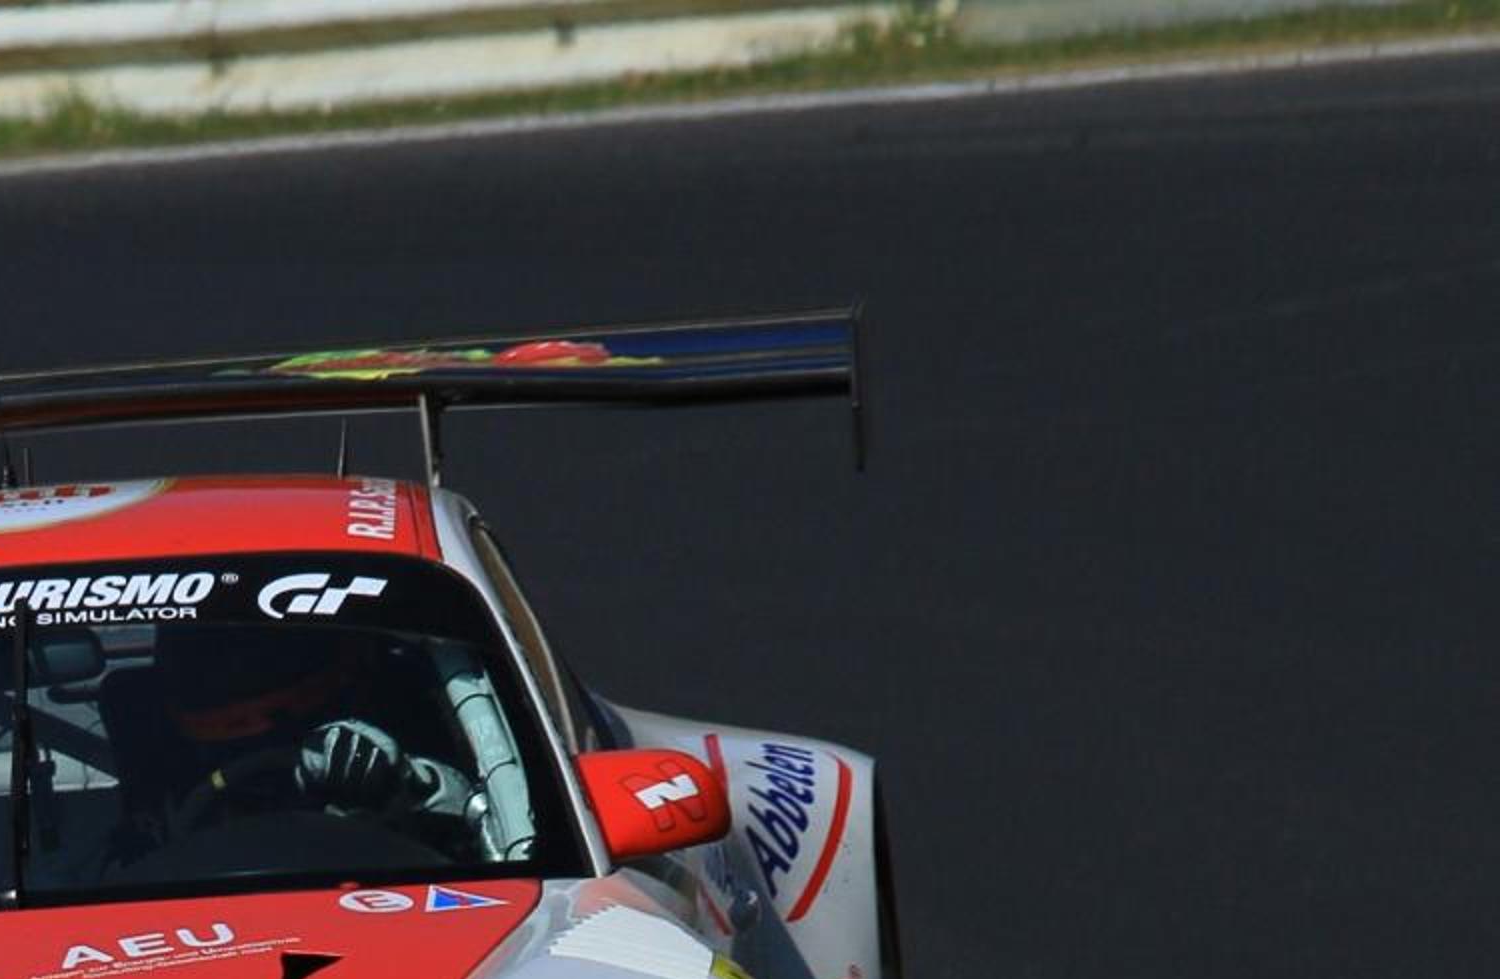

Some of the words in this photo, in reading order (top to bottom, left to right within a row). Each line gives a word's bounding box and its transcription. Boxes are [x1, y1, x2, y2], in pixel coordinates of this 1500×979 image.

[36, 607, 197, 625] SIMULATOR
[745, 743, 815, 899] Abbelen
[62, 924, 234, 969] AEU
